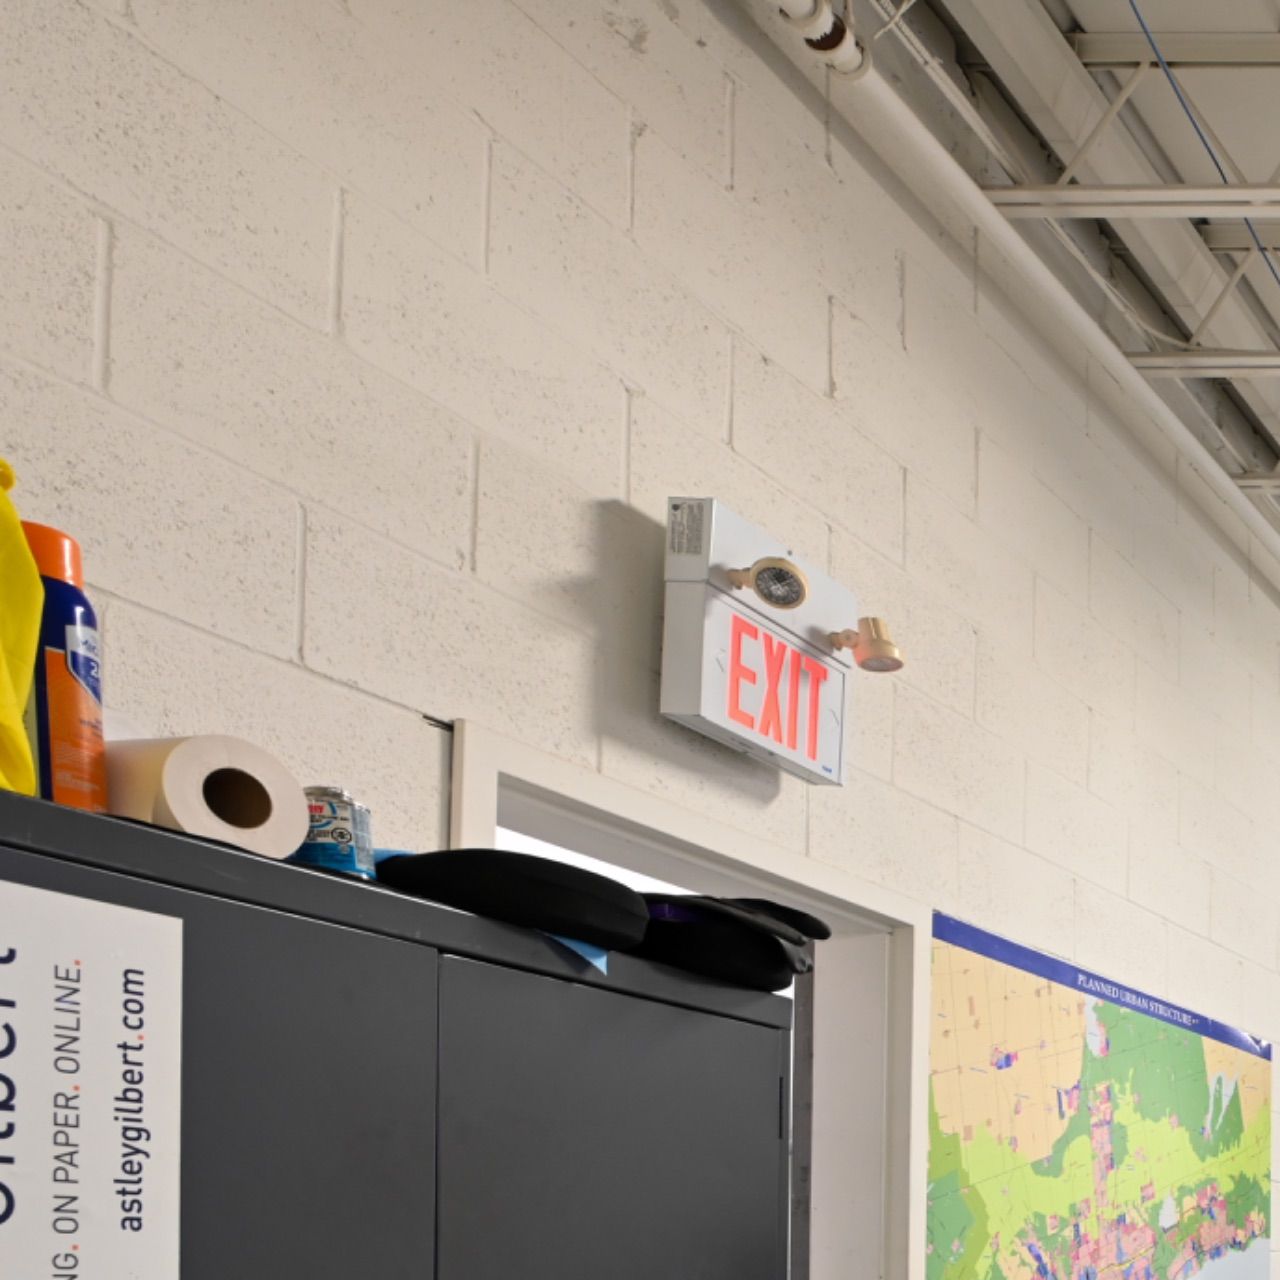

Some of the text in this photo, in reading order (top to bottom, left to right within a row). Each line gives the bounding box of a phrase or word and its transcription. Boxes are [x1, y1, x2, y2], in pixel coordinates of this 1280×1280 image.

[728, 613, 829, 761] EXIT
[53, 959, 82, 1074] ONLINE.
[1078, 973, 1193, 1026] PLANNED URBAN STRUCTURE
[53, 1084, 81, 1184] PAPER.
[113, 968, 151, 1232] astleygilbert.com
[53, 1195, 79, 1234] ON
